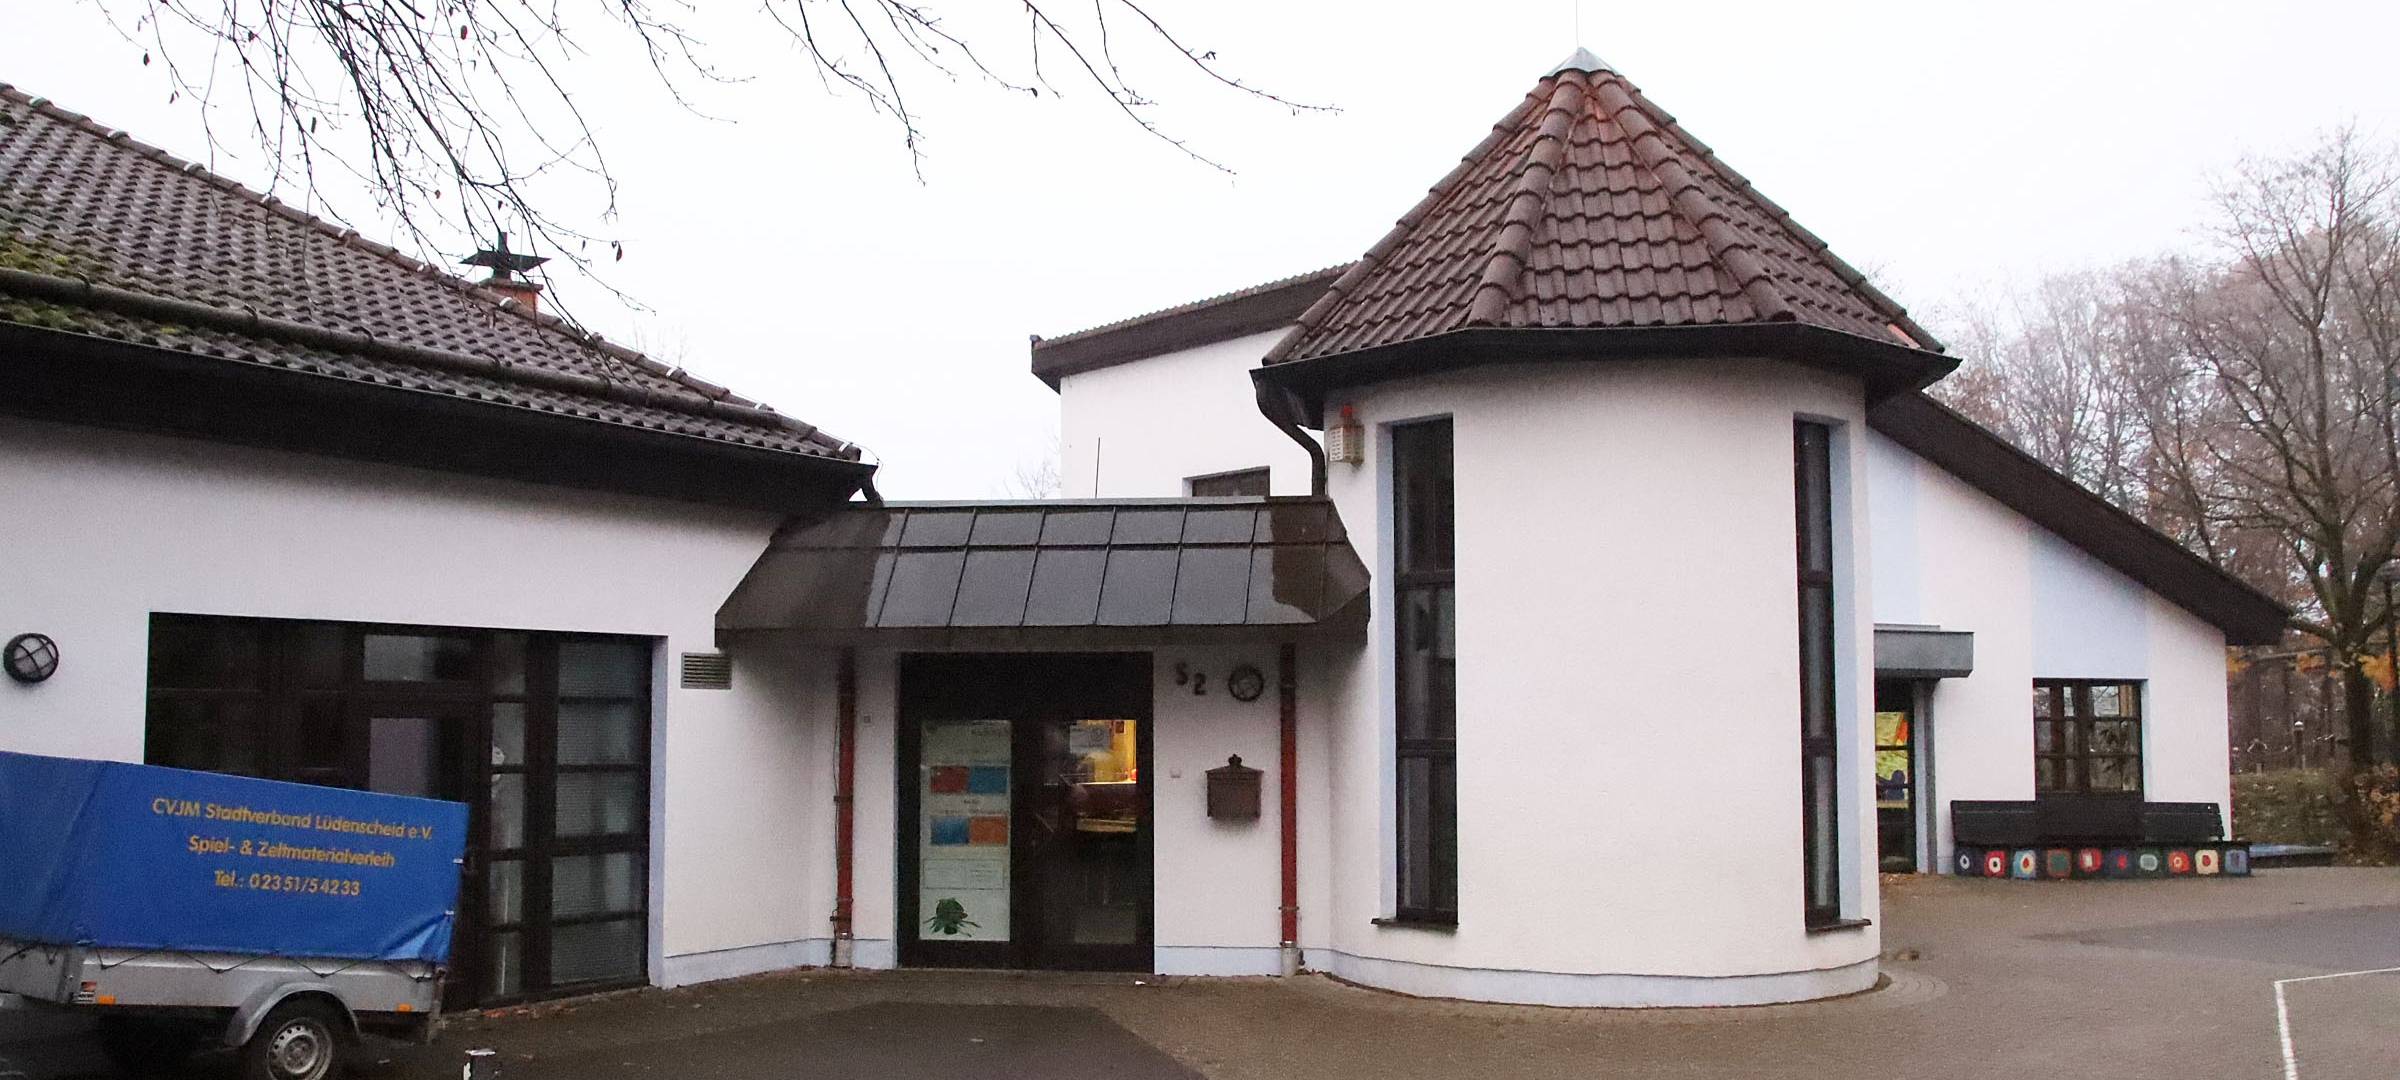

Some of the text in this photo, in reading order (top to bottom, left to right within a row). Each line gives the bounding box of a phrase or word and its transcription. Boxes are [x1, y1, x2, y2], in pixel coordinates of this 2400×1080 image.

[152, 797, 201, 817] CVJM
[205, 802, 312, 829] Stadtverband
[315, 814, 405, 837] Lüdenscheid
[188, 834, 395, 867] Spiel- & Zeltmaterialverleih
[214, 869, 244, 888] Tel.:
